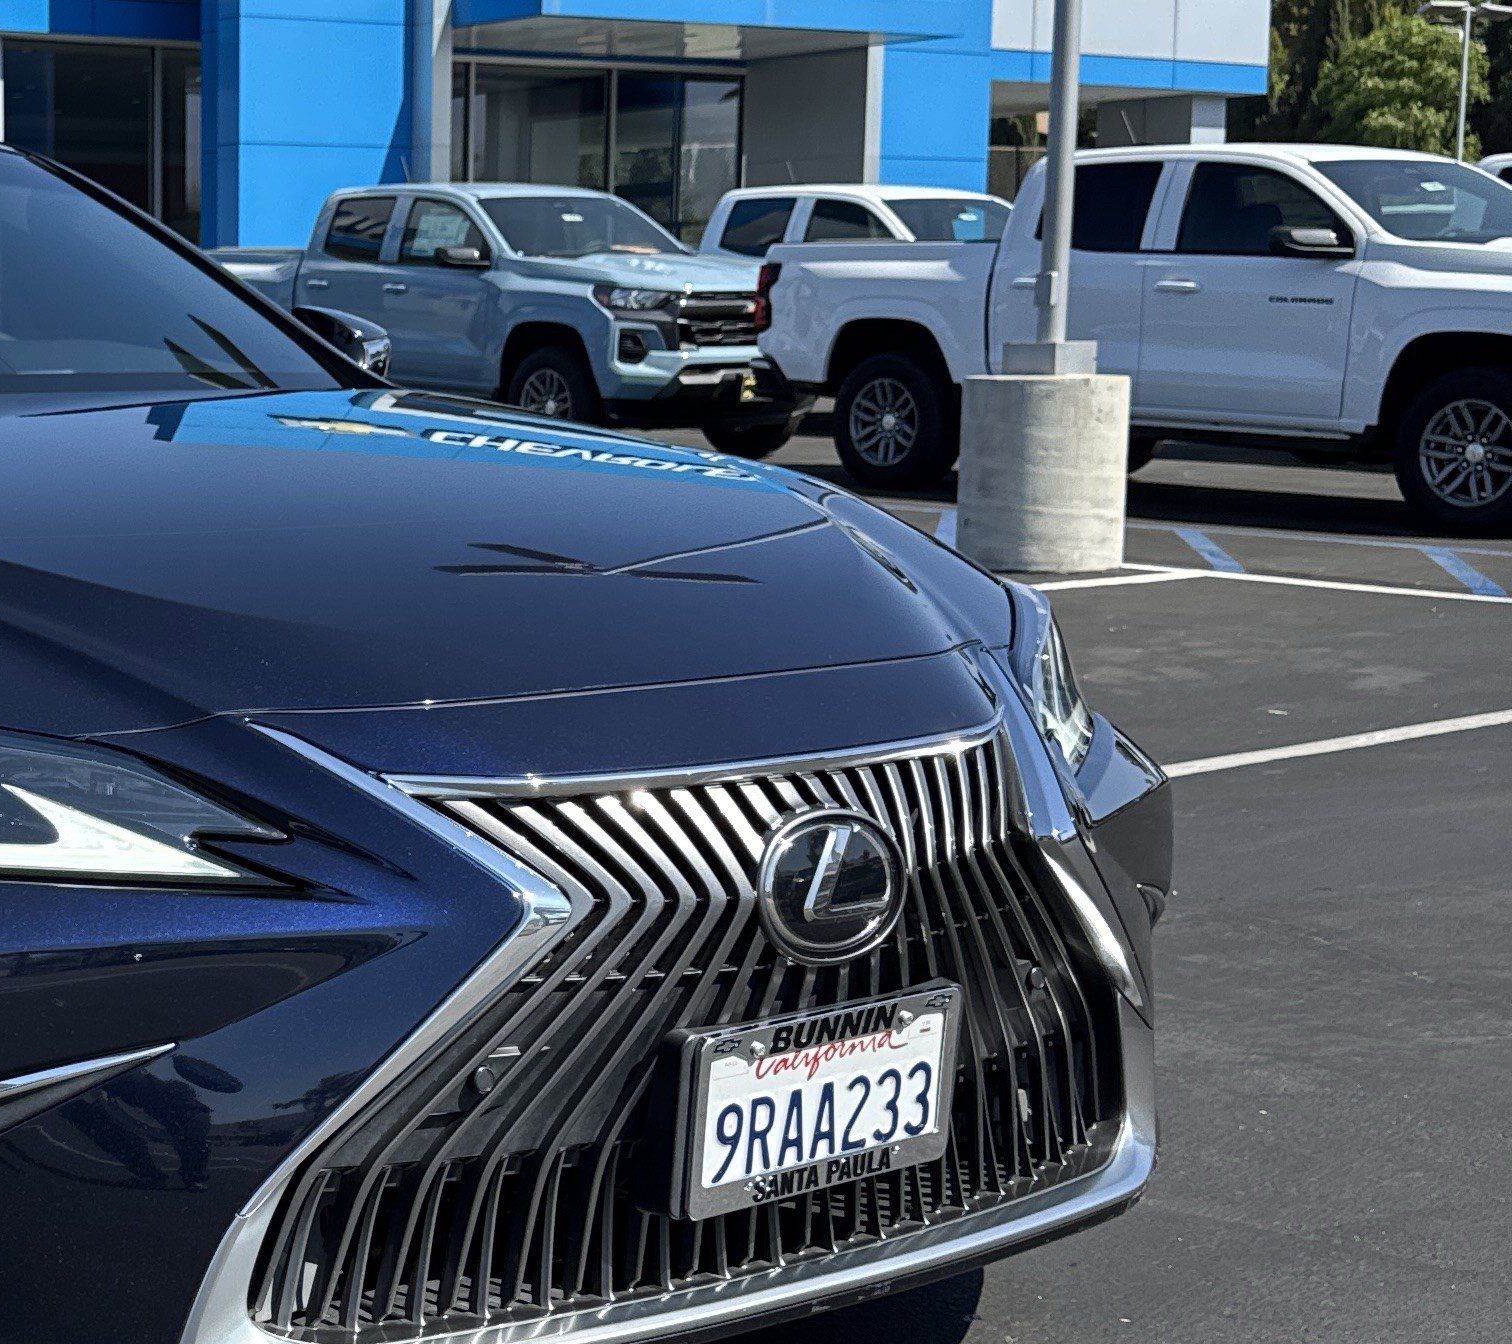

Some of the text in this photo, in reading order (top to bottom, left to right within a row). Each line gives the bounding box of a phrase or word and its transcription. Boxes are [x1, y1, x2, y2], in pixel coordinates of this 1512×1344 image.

[754, 1030, 909, 1081] California
[769, 1002, 899, 1055] BUNNIN
[711, 1061, 933, 1184] 9RAA233
[752, 1146, 891, 1203] SANTA PAULA
